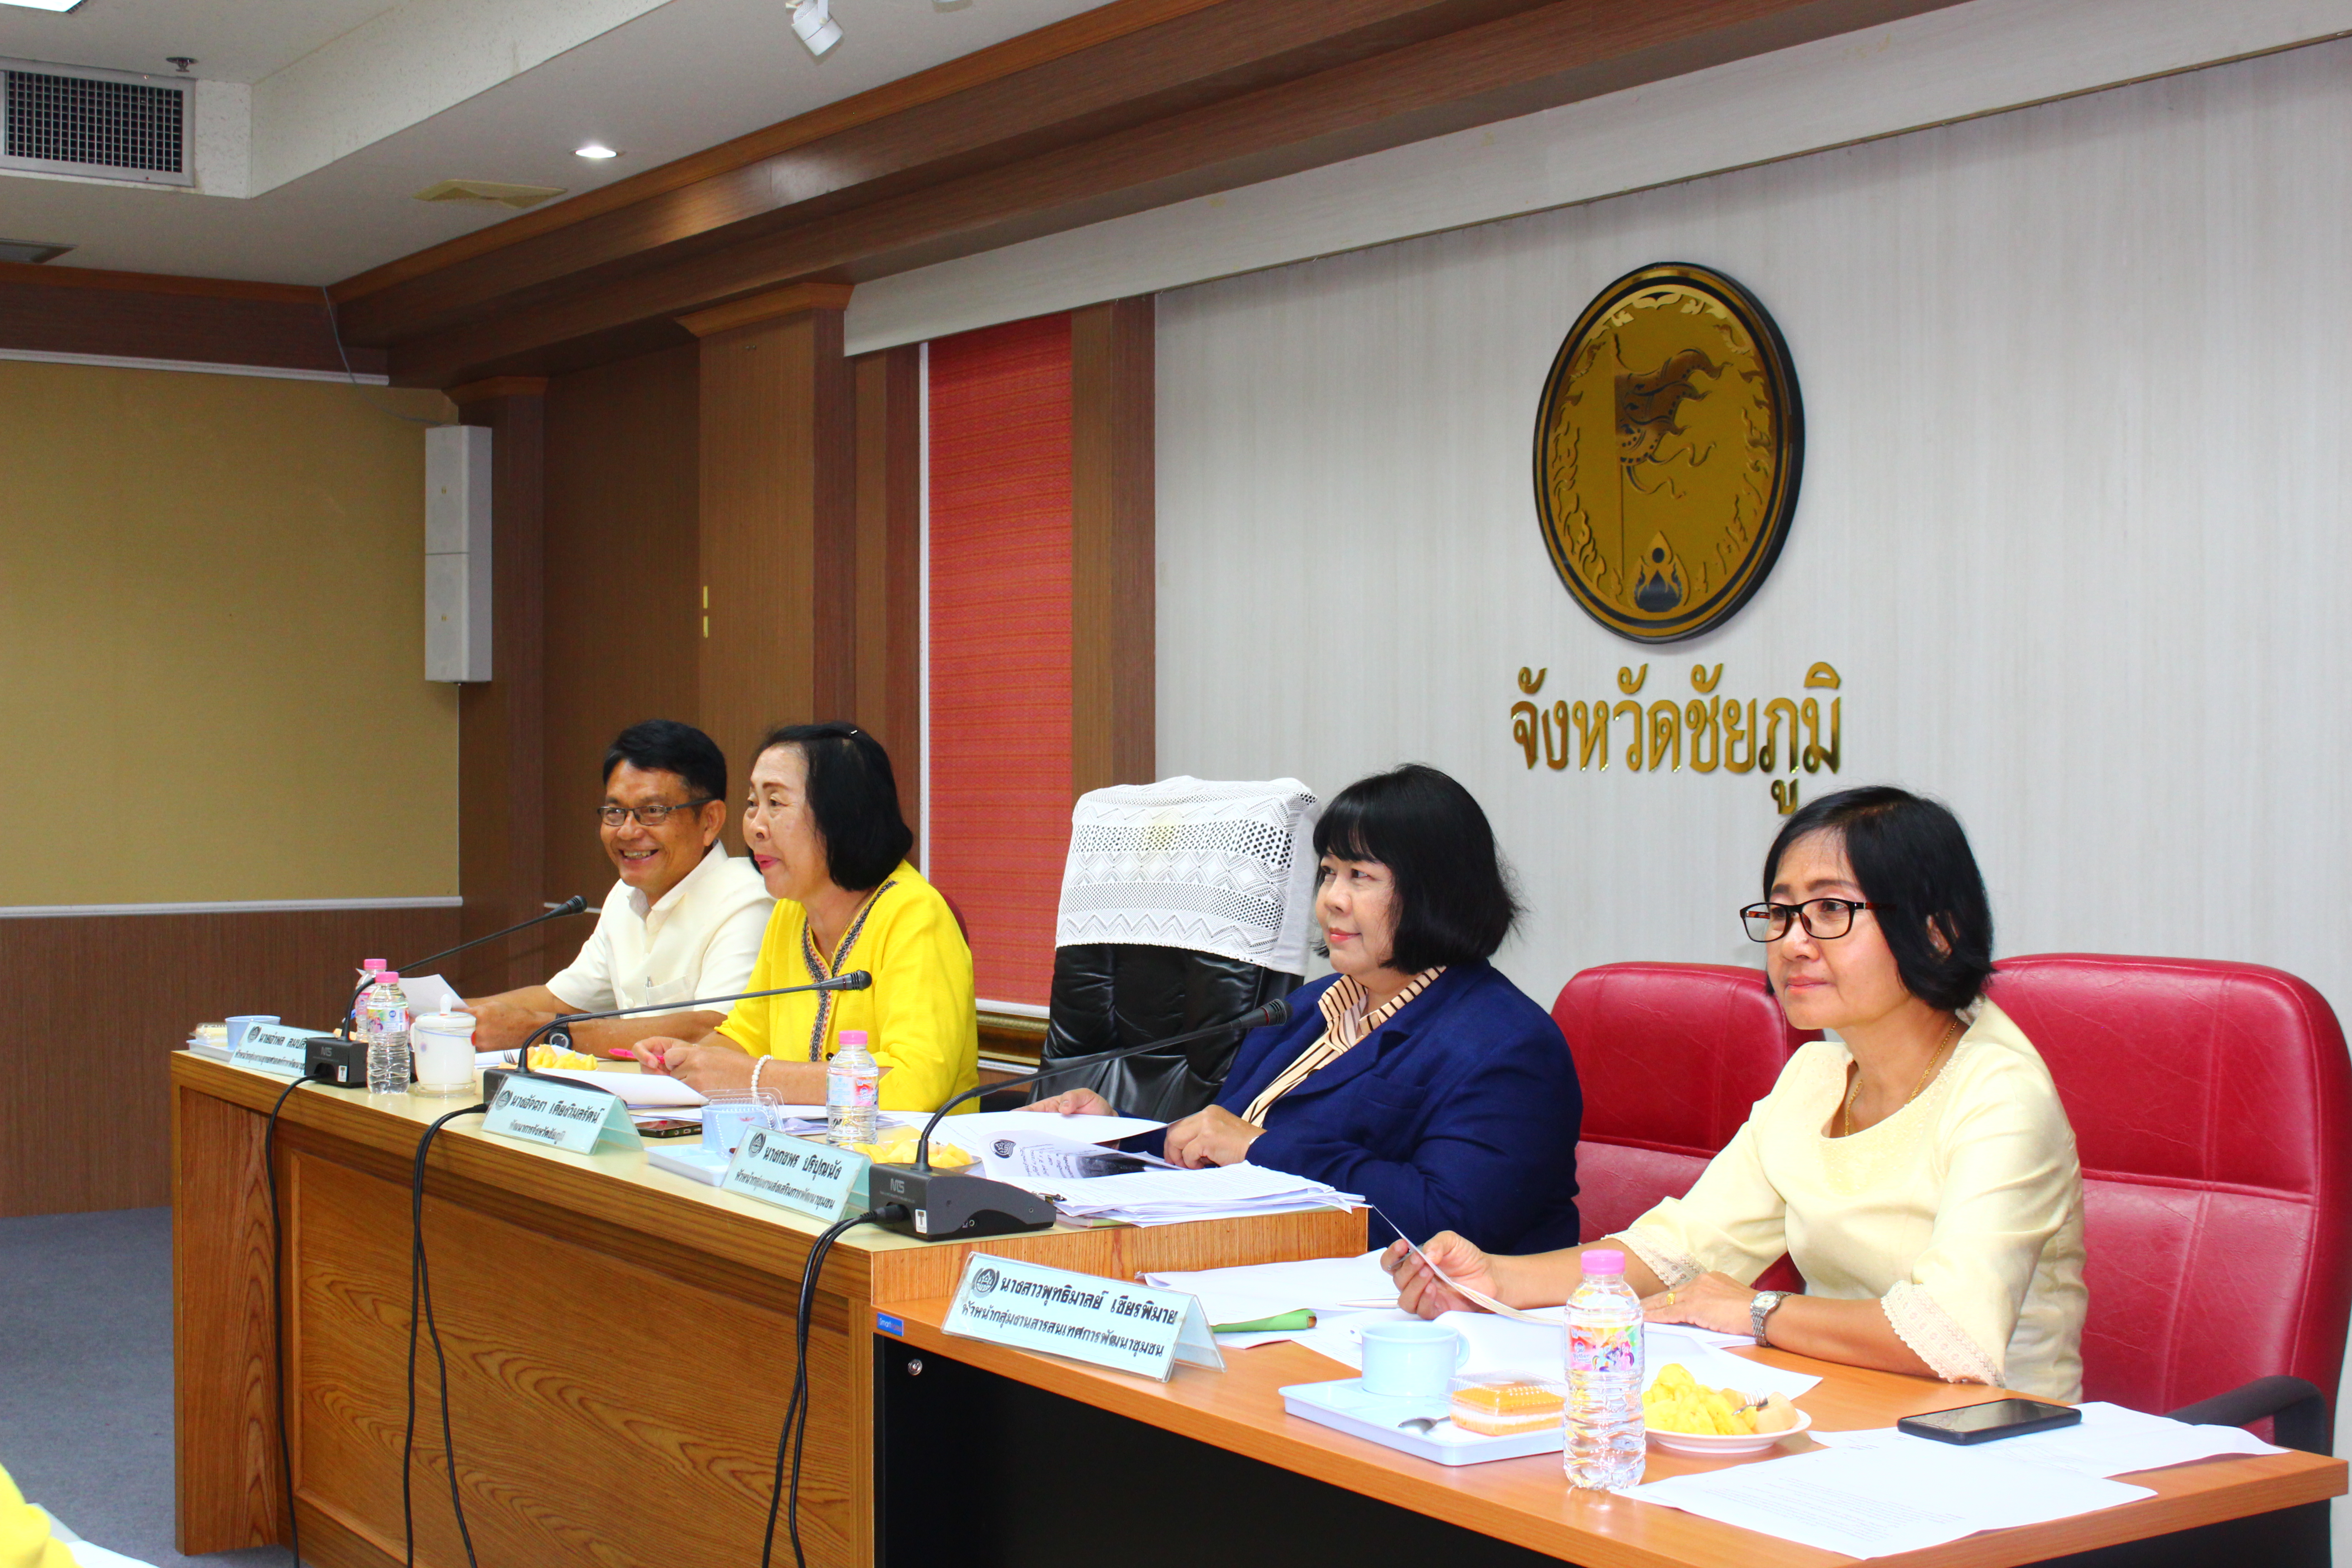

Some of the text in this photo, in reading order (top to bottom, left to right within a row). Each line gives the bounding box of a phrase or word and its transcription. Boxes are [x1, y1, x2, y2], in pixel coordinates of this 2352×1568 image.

[1511, 662, 1841, 814] จังหวัดชัยภูมิ
[510, 1094, 548, 1112] นางอัจฉรา
[763, 1147, 801, 1168] นางกชพร
[1000, 1277, 1109, 1310] นางสาวพุทธิมาลย์
[961, 1300, 1165, 1357] หัวหน้ากลุ่มงานสารสนเทศการพัฒนาชุมชน
